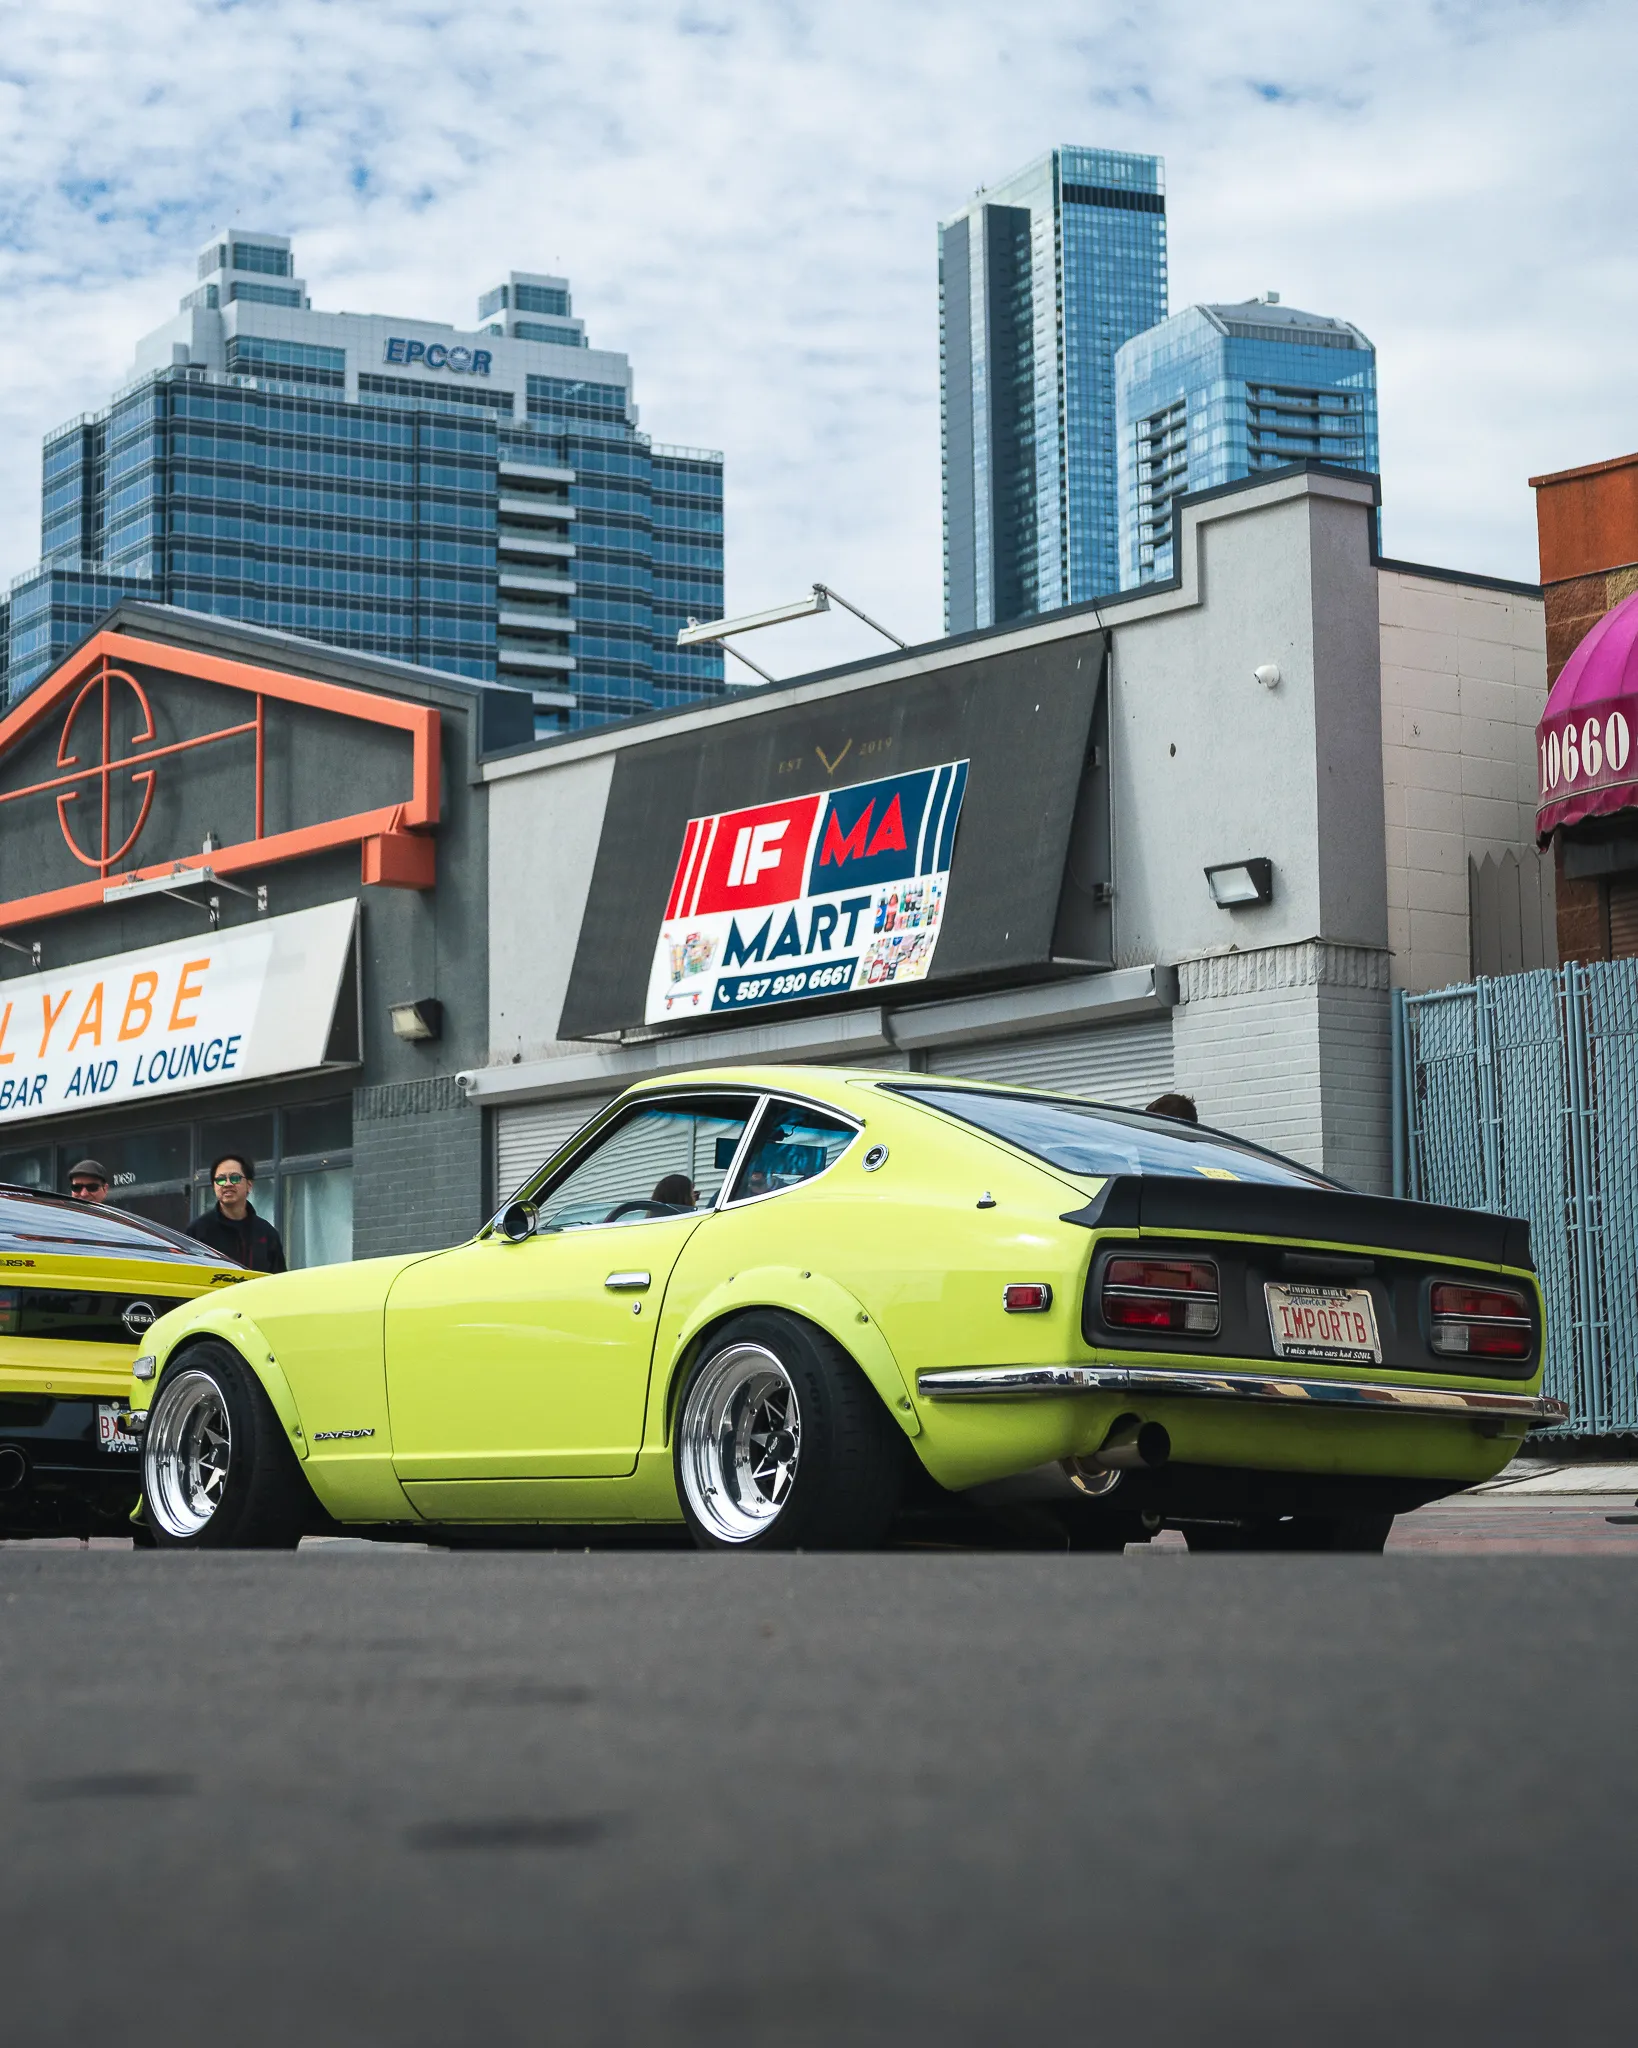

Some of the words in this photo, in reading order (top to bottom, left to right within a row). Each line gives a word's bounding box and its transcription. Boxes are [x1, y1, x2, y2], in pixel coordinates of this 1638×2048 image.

[385, 337, 493, 375] EPCOR
[1541, 712, 1630, 794] 10660
[726, 819, 791, 887] IF
[819, 792, 907, 867] MA
[721, 895, 872, 969] MART
[735, 977, 771, 1001] 587
[771, 972, 807, 995] 930
[808, 964, 852, 990] 6661
[0, 1074, 48, 1110] BAR
[64, 1060, 118, 1098] AND
[132, 1035, 242, 1087] LOUNGE
[1291, 1286, 1320, 1295] IMPORT
[1279, 1305, 1367, 1343] IMPORTB
[1291, 1347, 1306, 1355] miss
[313, 1428, 375, 1441] DATSUN
